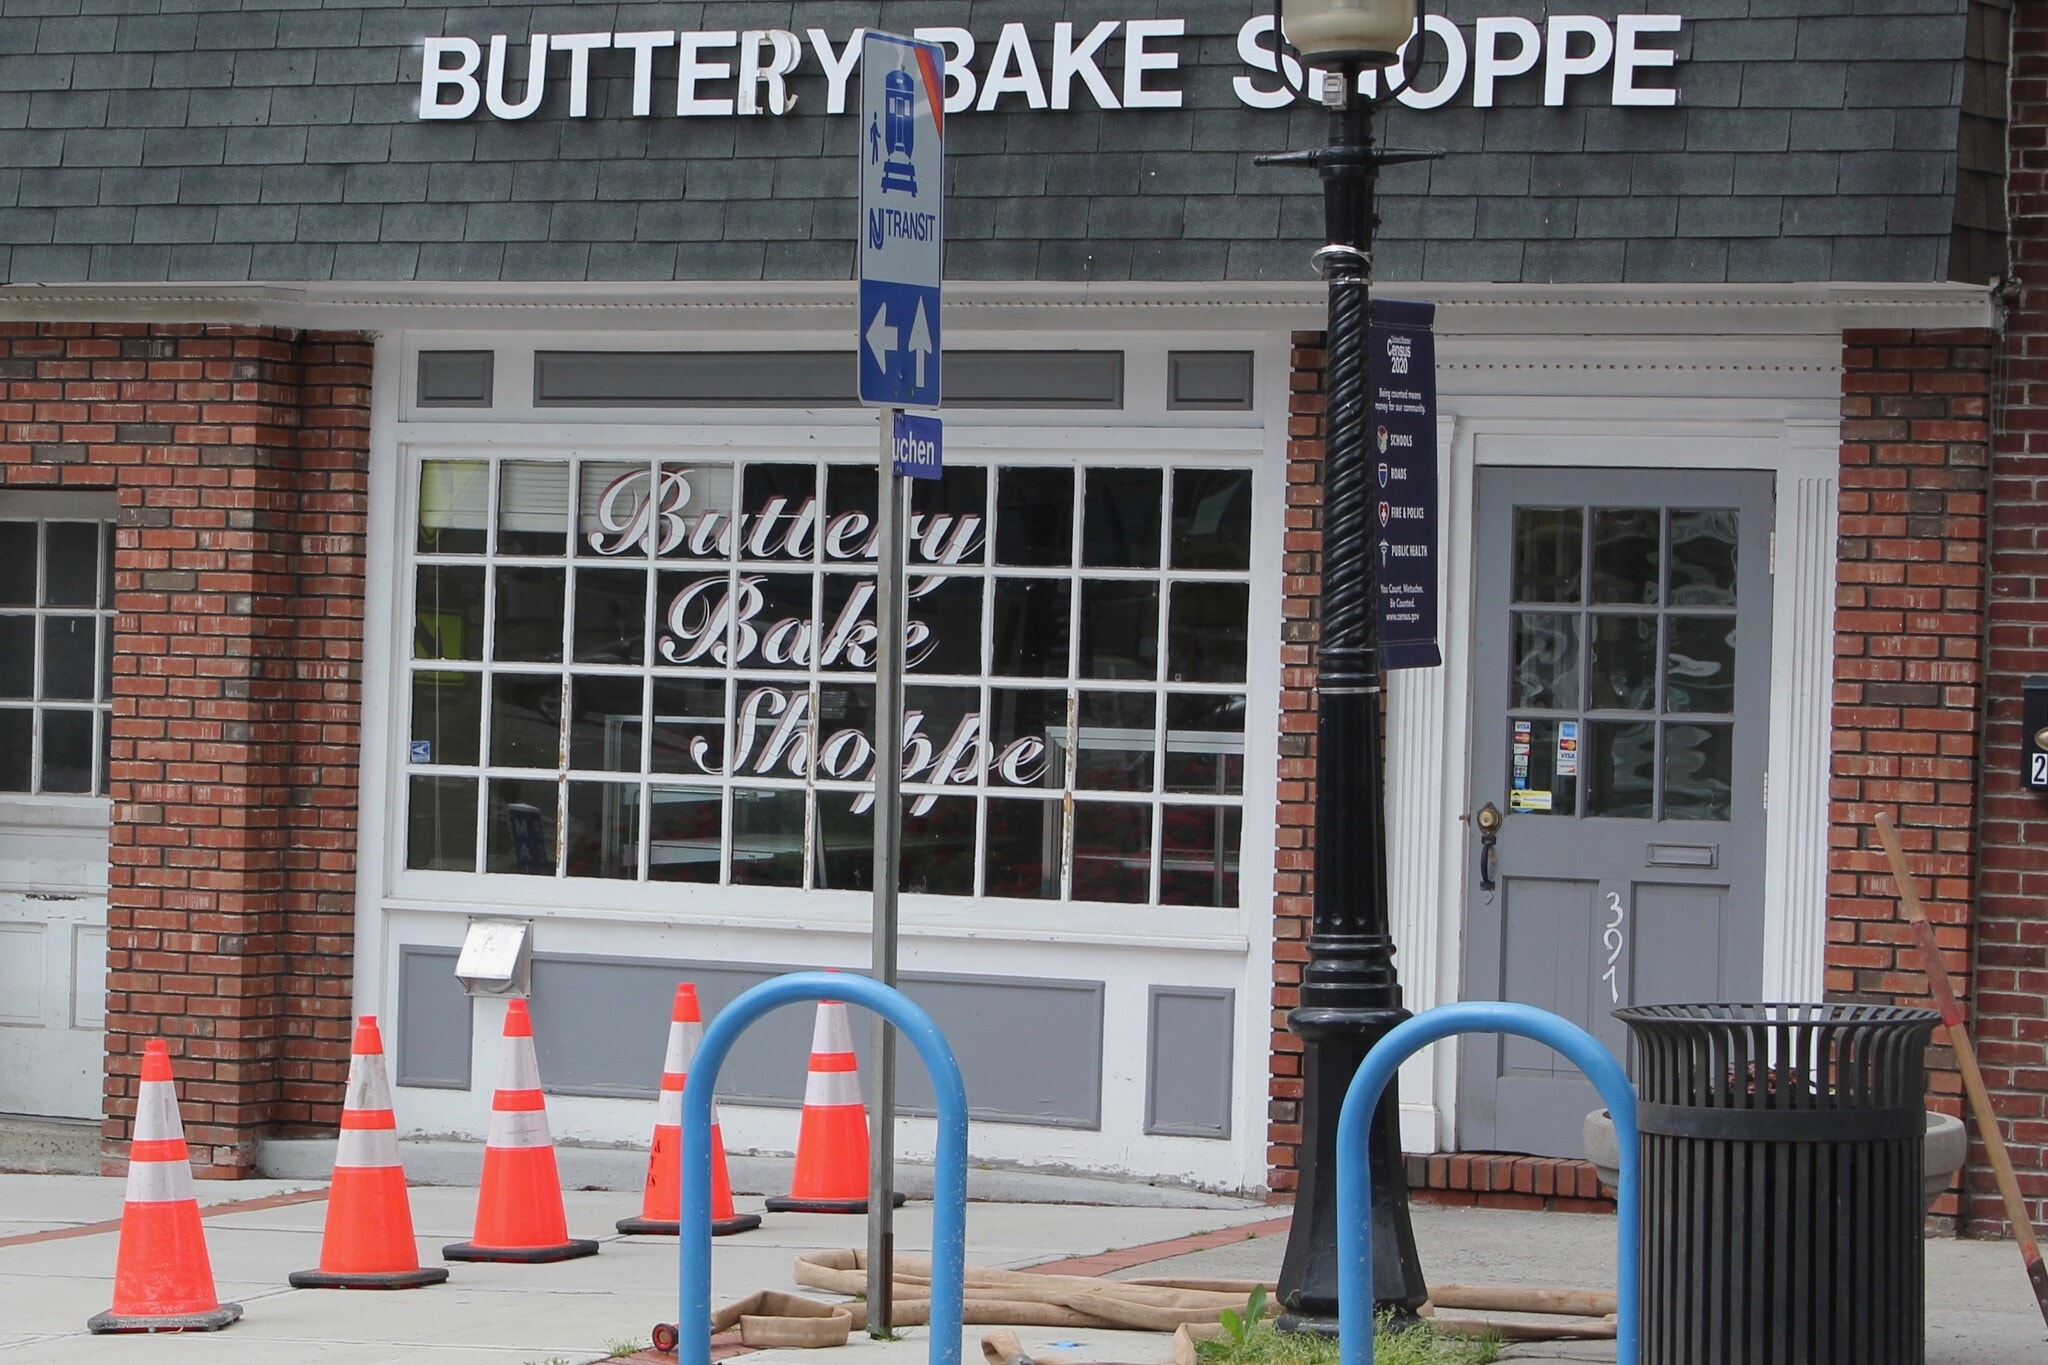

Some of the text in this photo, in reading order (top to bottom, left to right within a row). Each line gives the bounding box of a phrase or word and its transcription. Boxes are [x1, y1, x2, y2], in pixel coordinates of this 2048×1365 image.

[419, 27, 868, 120] BUTTERY
[914, 19, 1185, 113] BAKE
[885, 208, 936, 242] TRANSIT
[1387, 338, 1411, 358] Census
[1391, 356, 1408, 374] 2020
[1379, 387, 1421, 401] Being counted means
[1375, 402, 1388, 413] money
[1390, 433, 1412, 447] SCHOOLS
[1390, 467, 1407, 480] ROADS
[1391, 506, 1402, 519] FIRE
[1407, 506, 1424, 519] POLICE
[1391, 544, 1428, 557] PUBLIC HEALTH
[1380, 583, 1389, 594] You
[1390, 597, 1396, 608] Be
[659, 575, 939, 669] Bake
[690, 686, 1051, 817] Shoppe
[2033, 755, 2046, 783] 2
[1602, 891, 1624, 1005] 391
